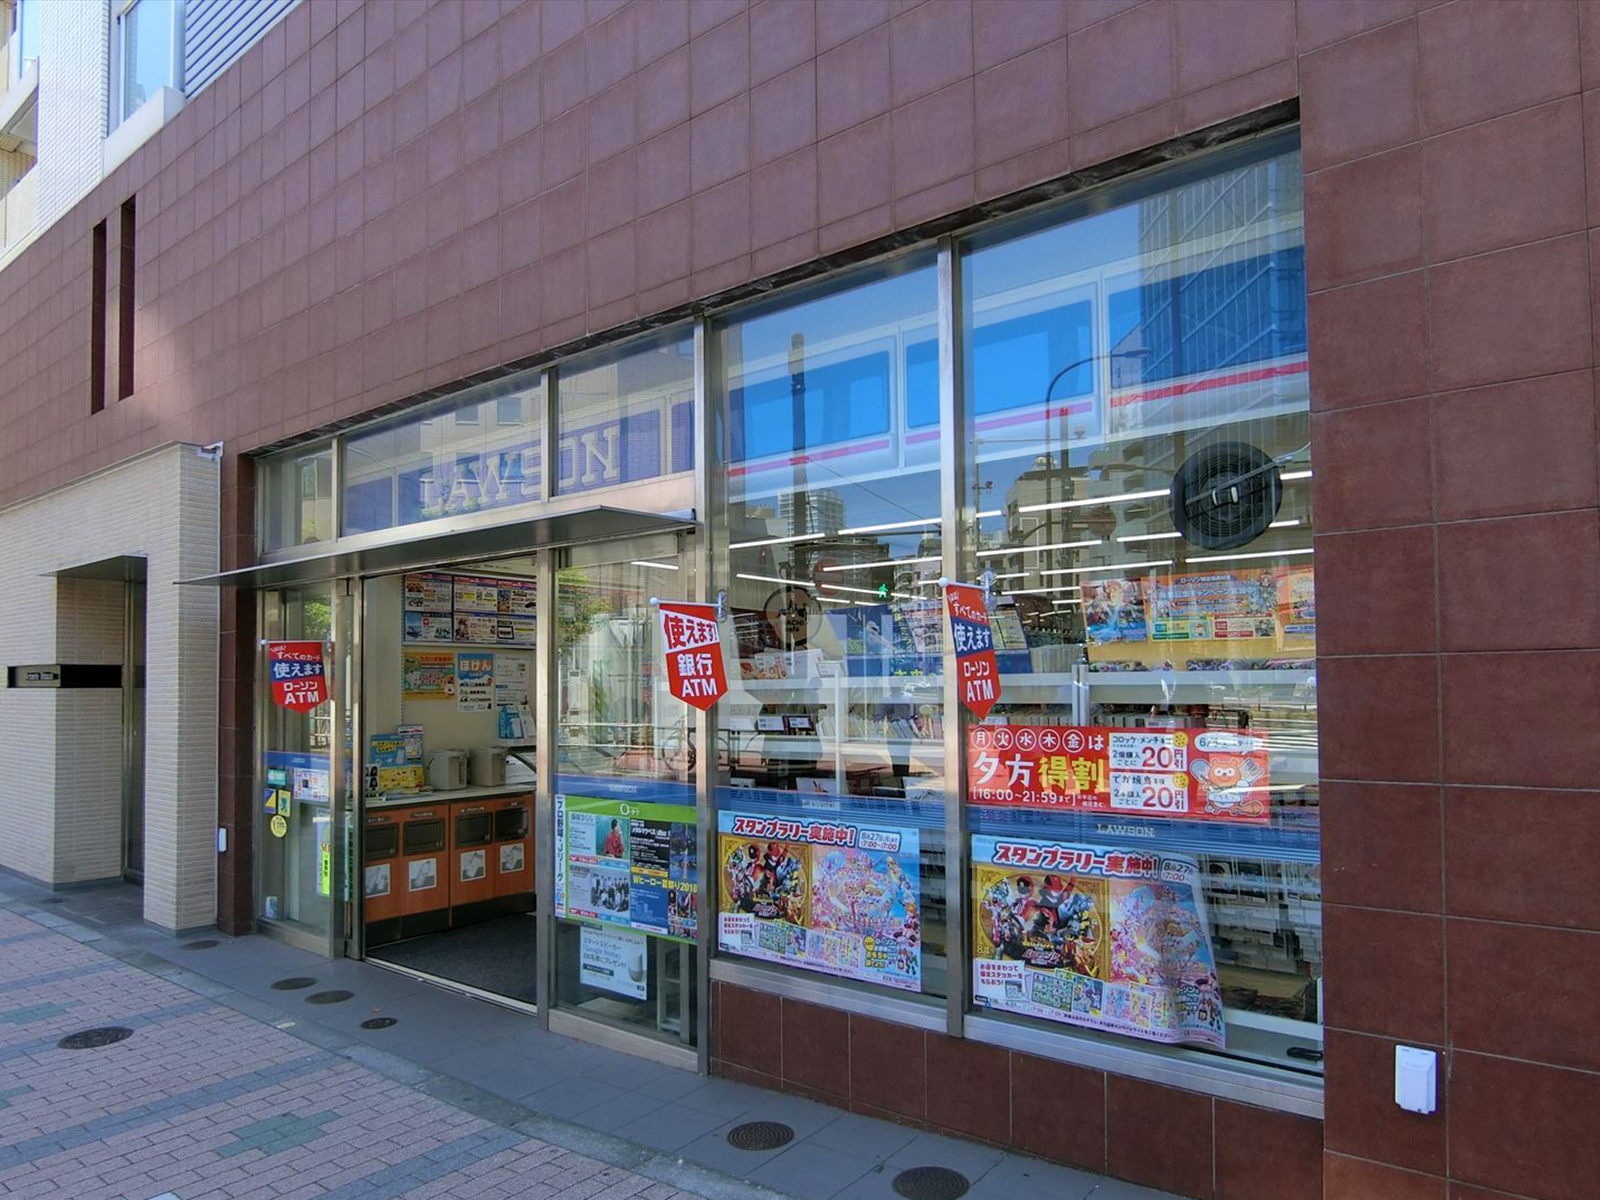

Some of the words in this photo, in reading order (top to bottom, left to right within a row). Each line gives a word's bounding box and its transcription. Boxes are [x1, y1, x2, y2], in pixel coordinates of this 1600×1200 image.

[954, 622, 991, 652] 使えます
[273, 662, 323, 679] 使えます
[460, 660, 492, 671] ほけん
[677, 653, 713, 678] 銀行
[963, 661, 990, 678] ローソン
[283, 681, 318, 692] ローソン
[284, 690, 320, 705] ATM
[682, 677, 718, 698] ATM
[966, 678, 995, 703] ATM
[1141, 746, 1174, 769] 20
[972, 750, 1105, 794] 夕方得割
[1142, 786, 1174, 809] 20
[733, 816, 856, 847] スタンプラリー実施中!
[1096, 823, 1157, 838] LAWSON
[994, 844, 1159, 880] スタンプラリー実施中!
